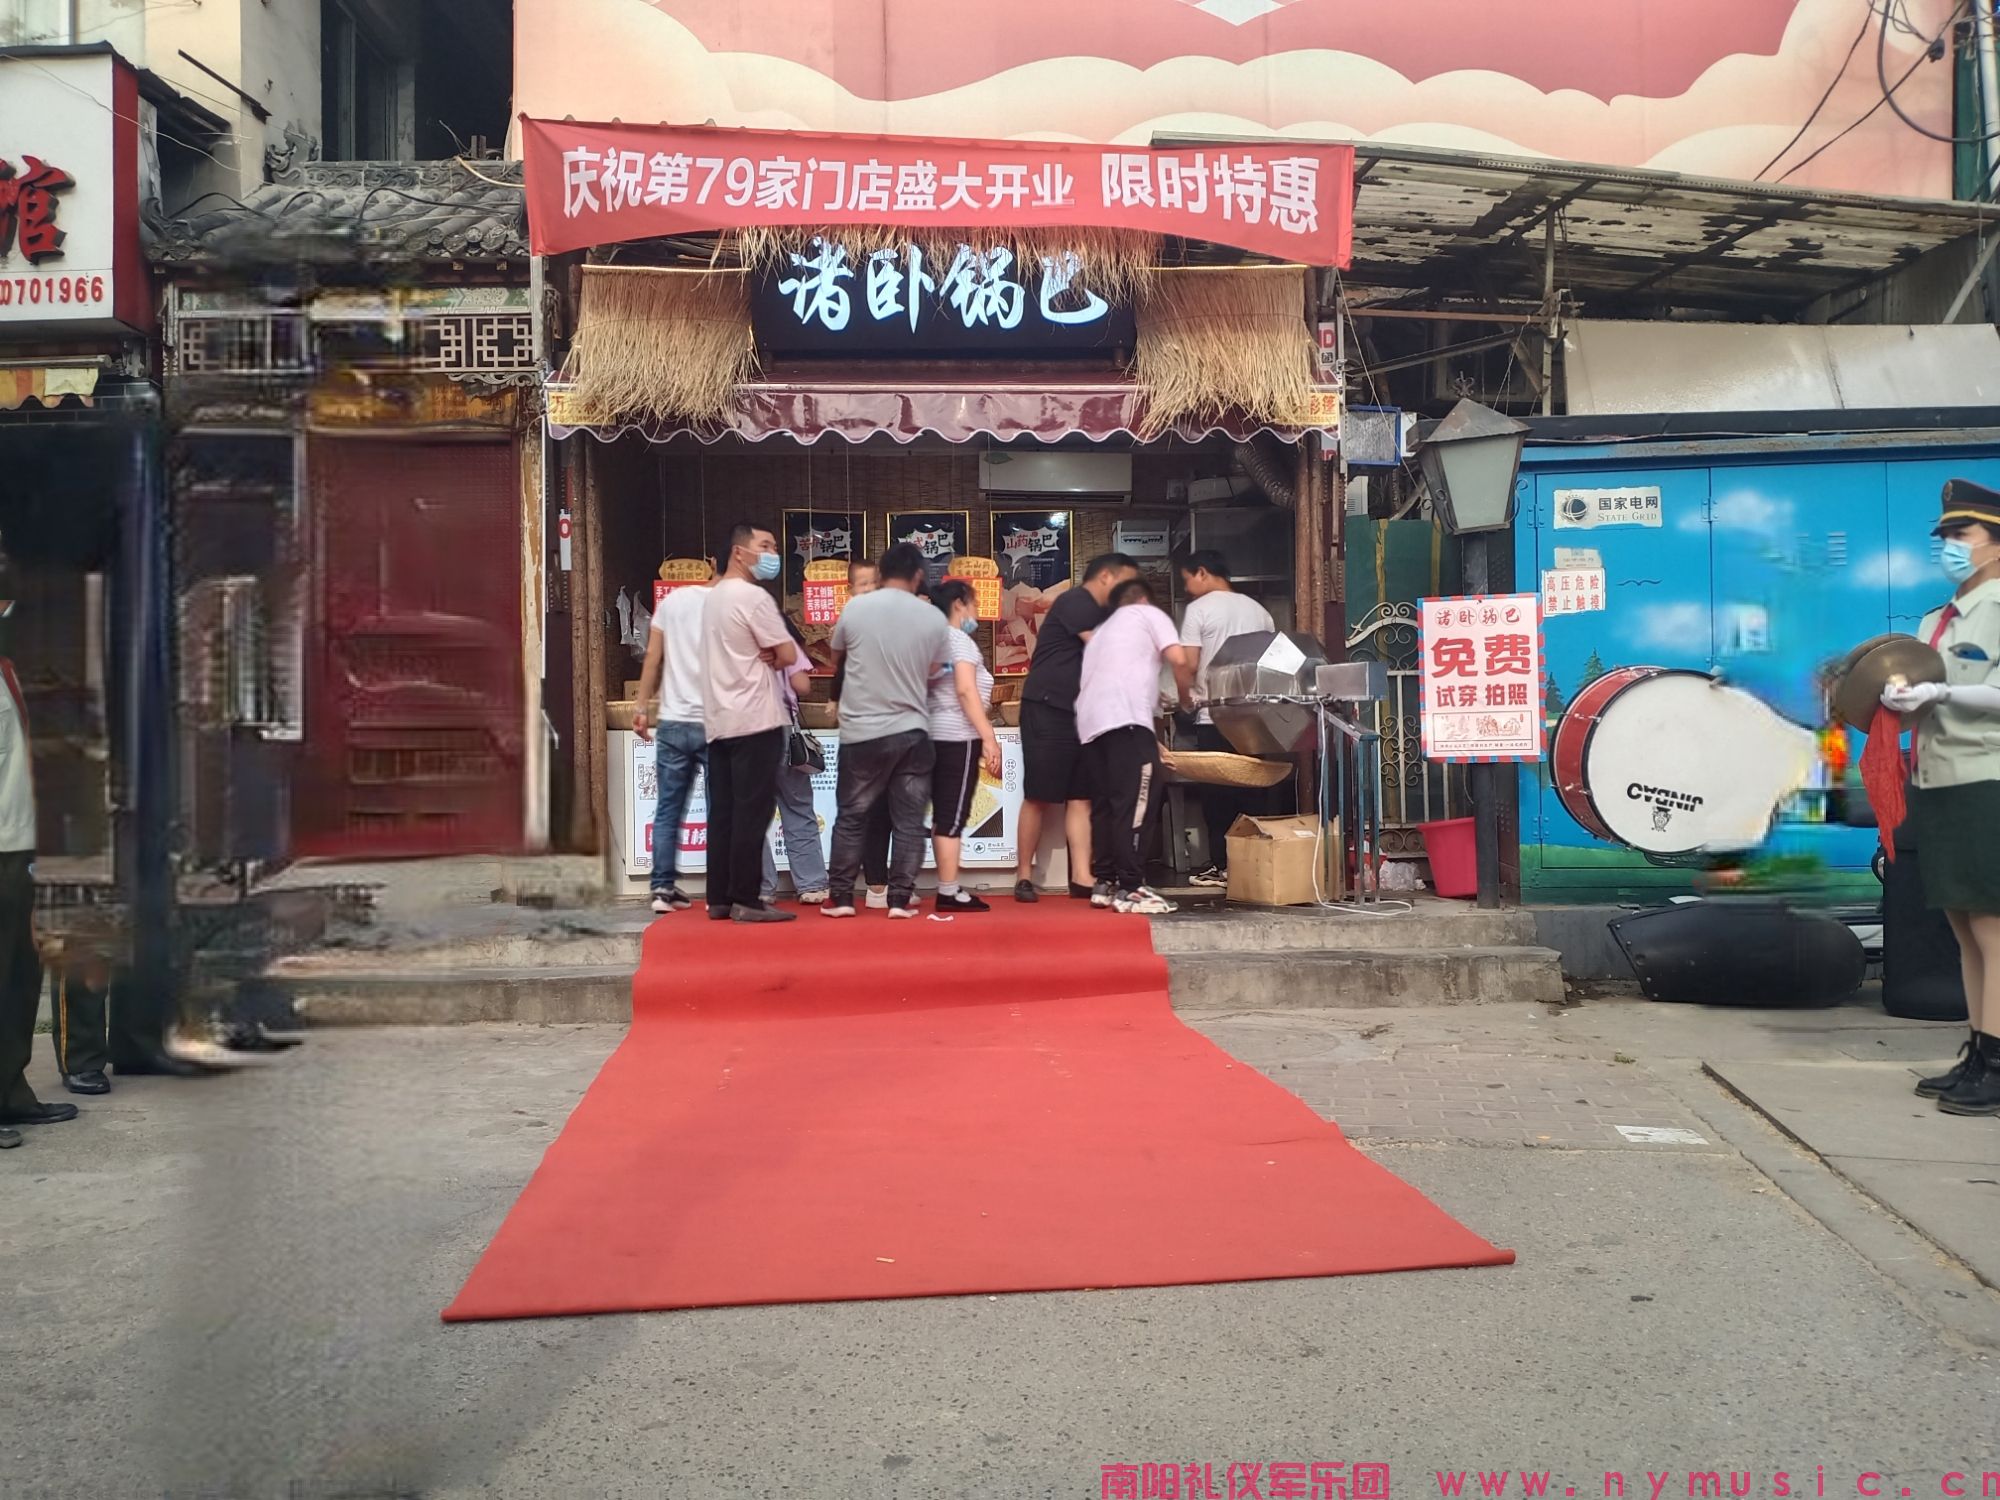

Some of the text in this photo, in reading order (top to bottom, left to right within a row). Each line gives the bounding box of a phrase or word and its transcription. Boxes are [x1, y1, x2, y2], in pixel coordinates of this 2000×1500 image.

[562, 146, 1320, 234] 庆祝第79家门店盛大开业 限时特惠
[1598, 496, 1658, 511] 国家电网
[1598, 511, 1657, 522] STATE GRID
[907, 532, 951, 555] 式锅巴
[1006, 533, 1056, 553] 山药锅巴
[1547, 574, 1600, 592] 高压危险
[1548, 594, 1600, 611] 禁止触摸
[1431, 633, 1532, 678] 免费
[1436, 683, 1528, 708] 试穿拍照
